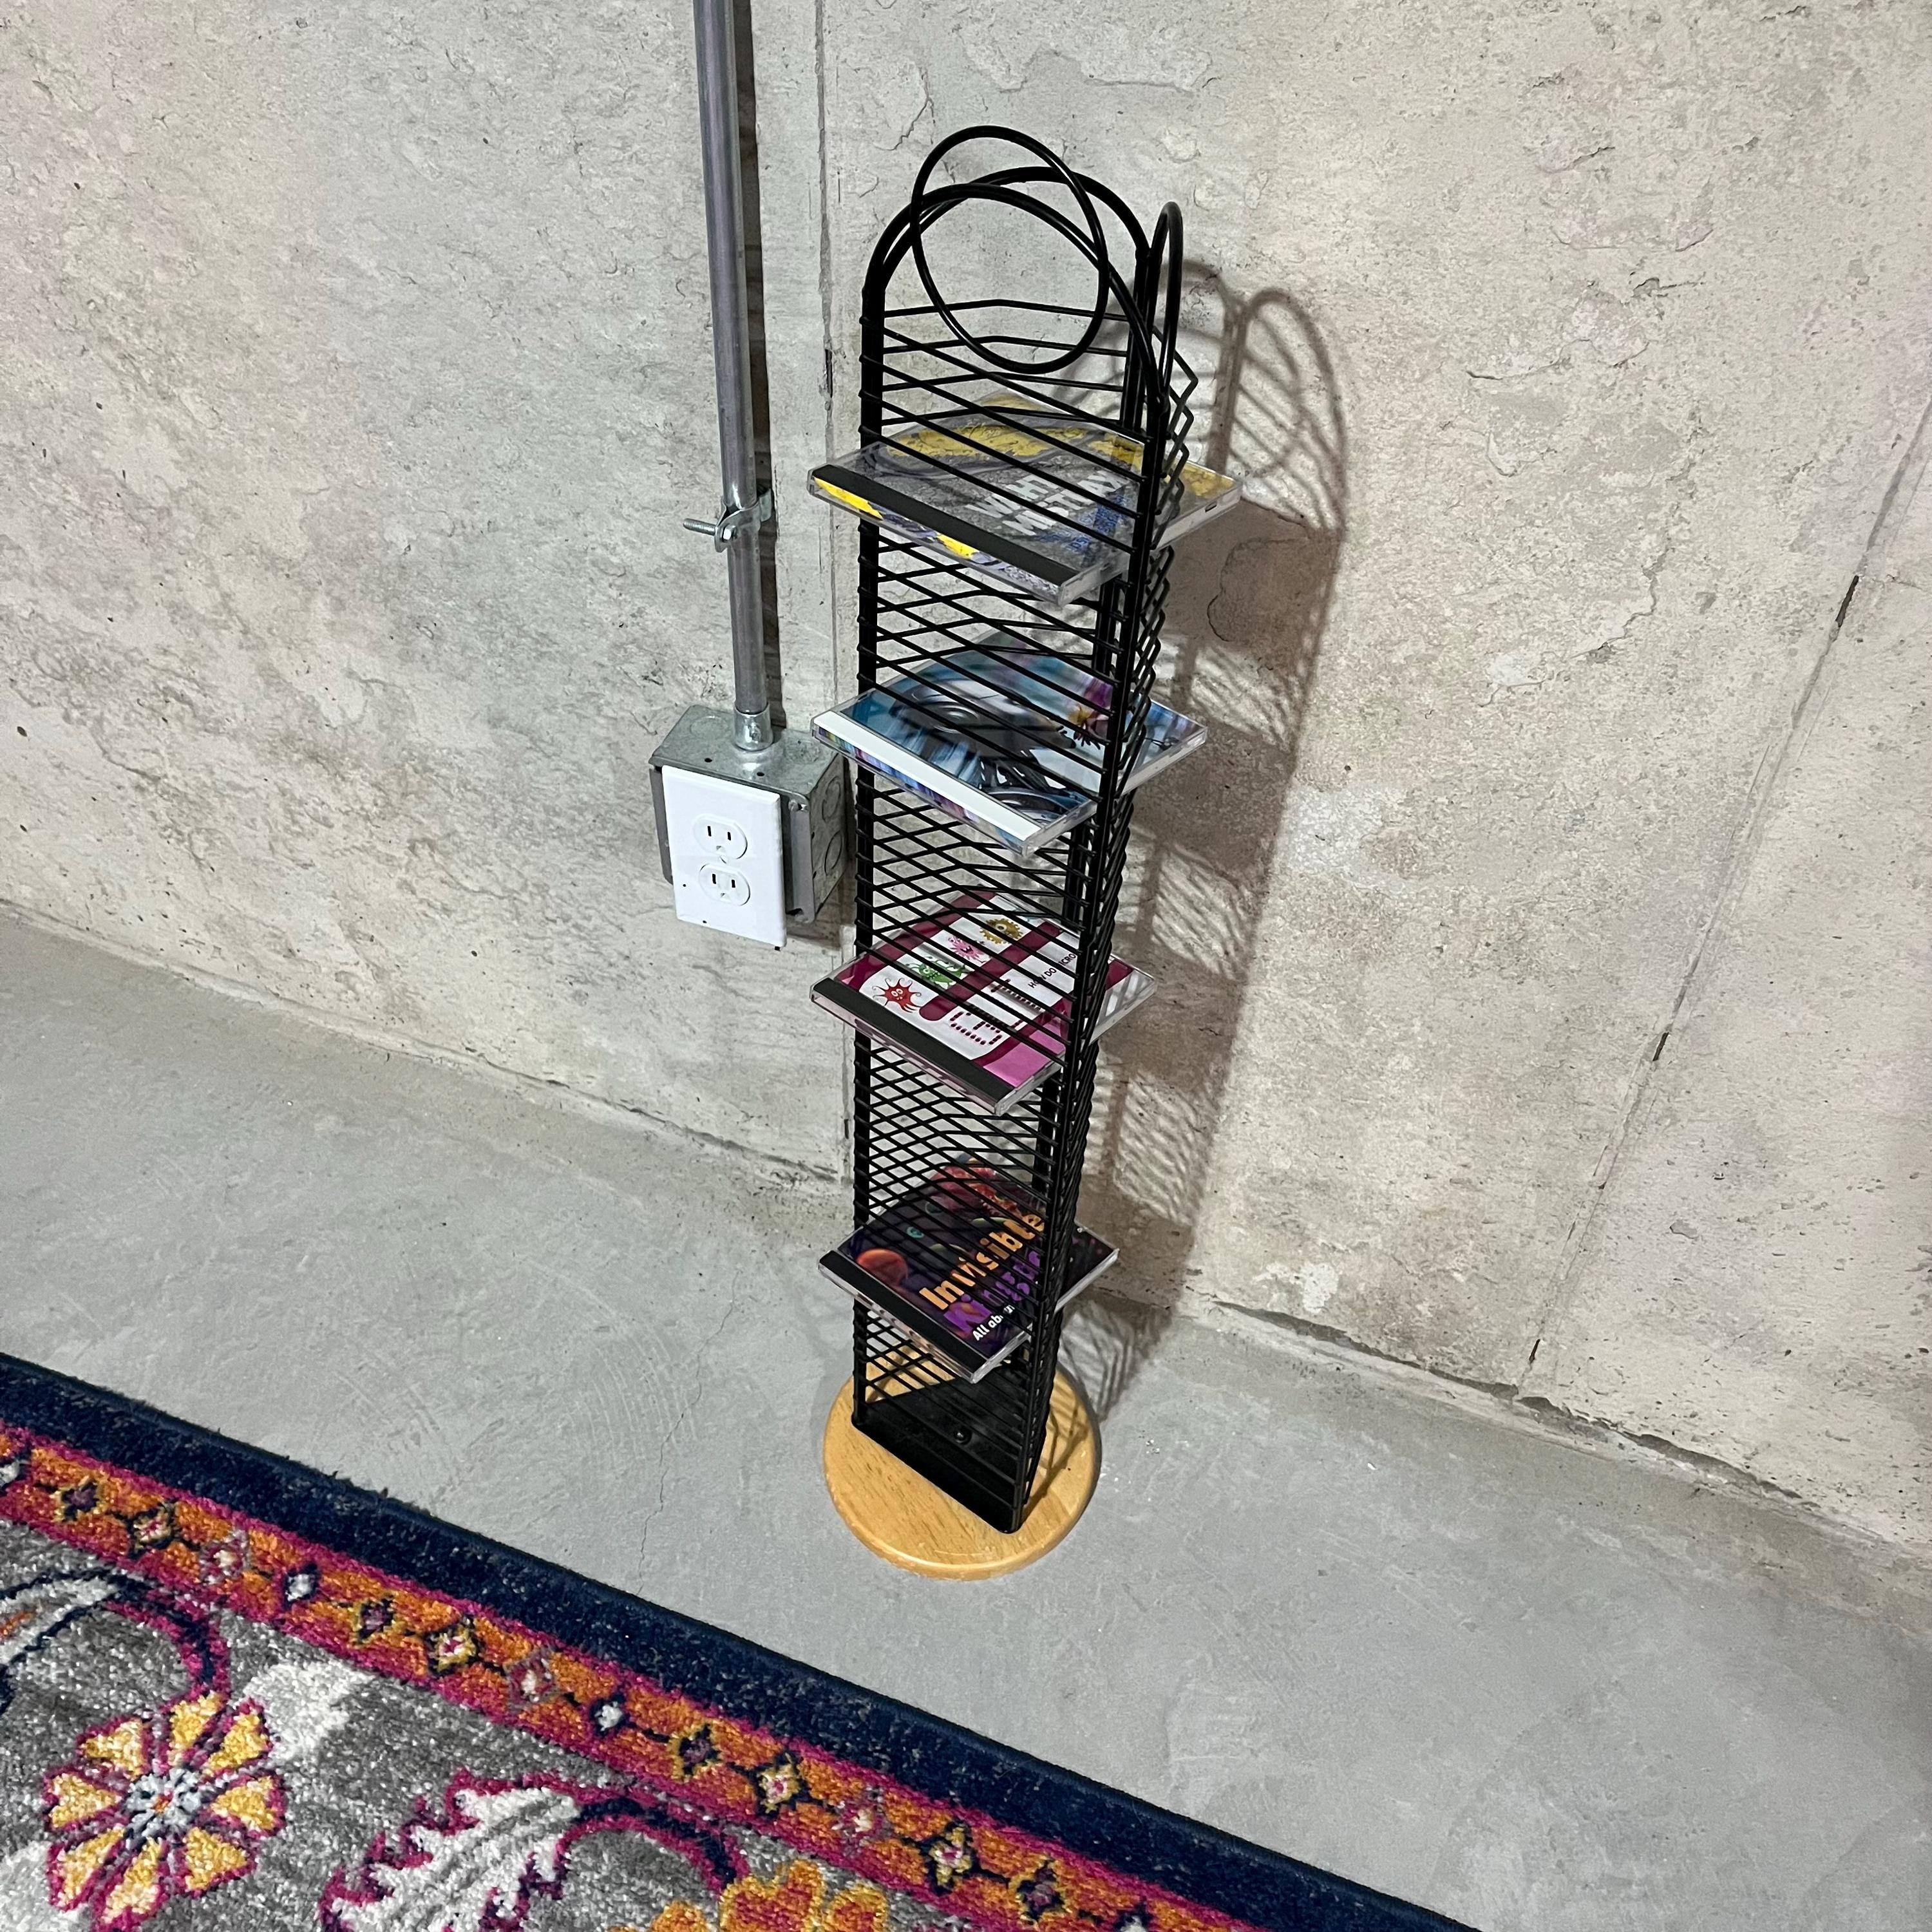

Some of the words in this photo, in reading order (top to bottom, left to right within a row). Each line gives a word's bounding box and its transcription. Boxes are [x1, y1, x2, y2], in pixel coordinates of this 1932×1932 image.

[1043, 967, 1057, 977] DO
[918, 1214, 1045, 1311] Invisible
[972, 1324, 990, 1341] All
